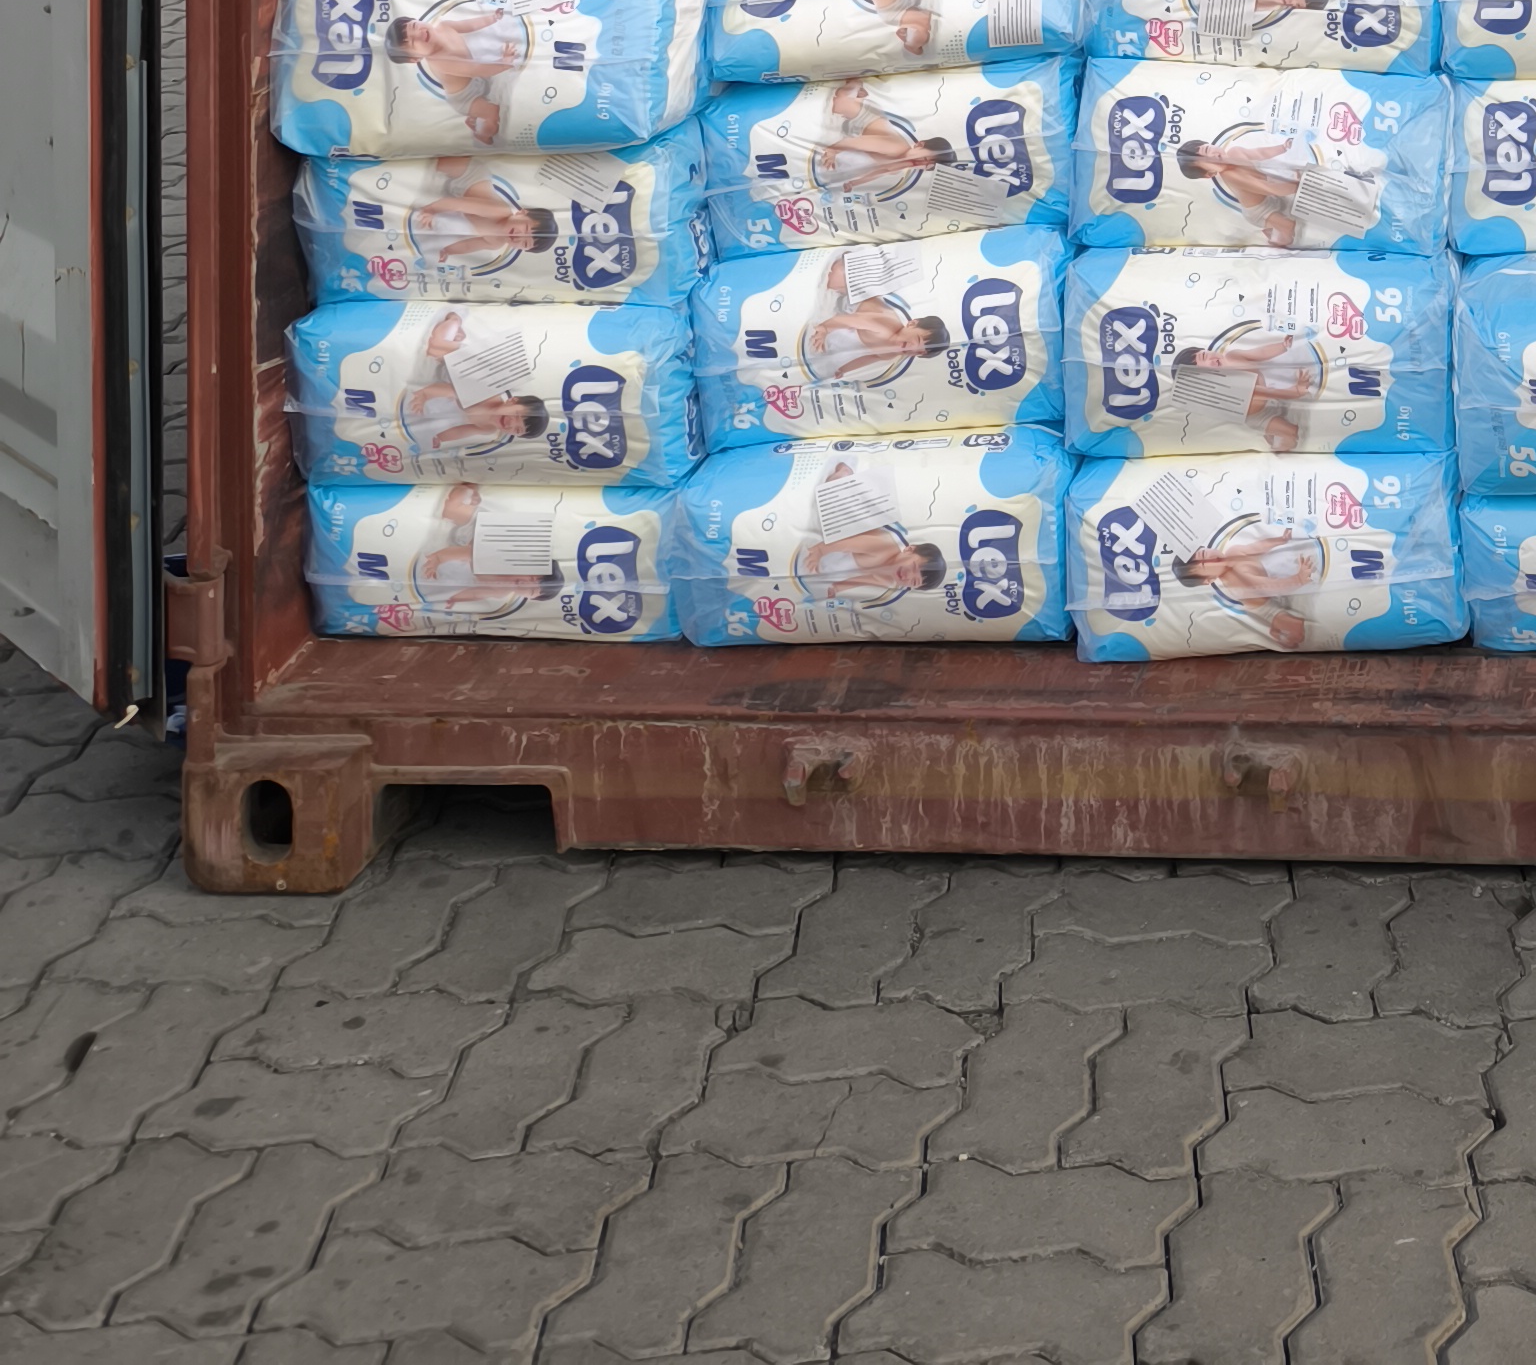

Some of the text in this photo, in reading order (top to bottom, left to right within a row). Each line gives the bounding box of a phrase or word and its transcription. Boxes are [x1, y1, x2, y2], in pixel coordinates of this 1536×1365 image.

[552, 41, 587, 71] M
[1168, 104, 1185, 145] baby
[1373, 101, 1401, 135] 56
[756, 154, 789, 179] M
[353, 201, 384, 229] M
[554, 246, 568, 283] baby
[1375, 288, 1401, 323] 56
[745, 329, 778, 358] M
[1104, 324, 1113, 349] new
[1161, 312, 1177, 354] baby
[946, 349, 964, 388] baby
[1348, 367, 1381, 397] M
[1509, 445, 1536, 477] 56
[1373, 475, 1401, 509] 56
[357, 552, 389, 580] M
[736, 548, 769, 577] M
[1351, 549, 1384, 580] M
